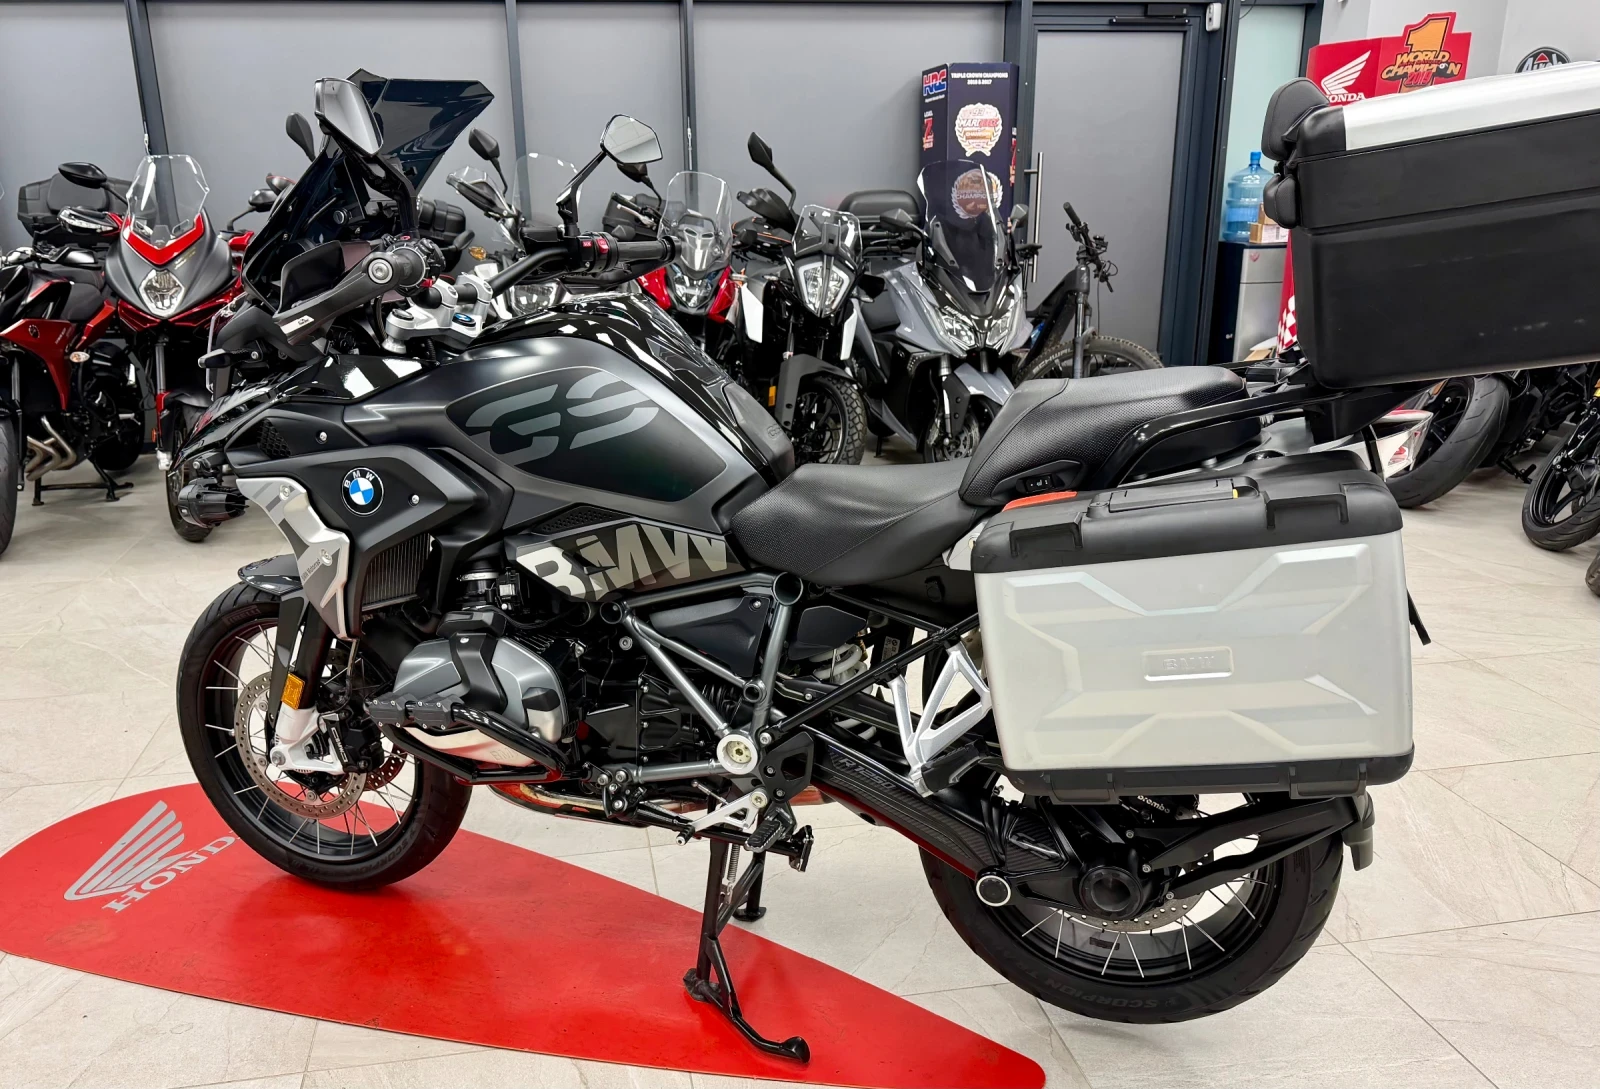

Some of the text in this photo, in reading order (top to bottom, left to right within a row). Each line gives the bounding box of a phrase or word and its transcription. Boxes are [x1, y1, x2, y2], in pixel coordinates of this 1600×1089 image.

[1396, 51, 1450, 68] WORLD
[1404, 71, 1433, 86] 2019
[1032, 347, 1074, 374] SCHWAL
[465, 372, 660, 466] GS
[344, 469, 375, 489] BMW
[490, 748, 519, 761] BM
[102, 830, 241, 914] HOND
